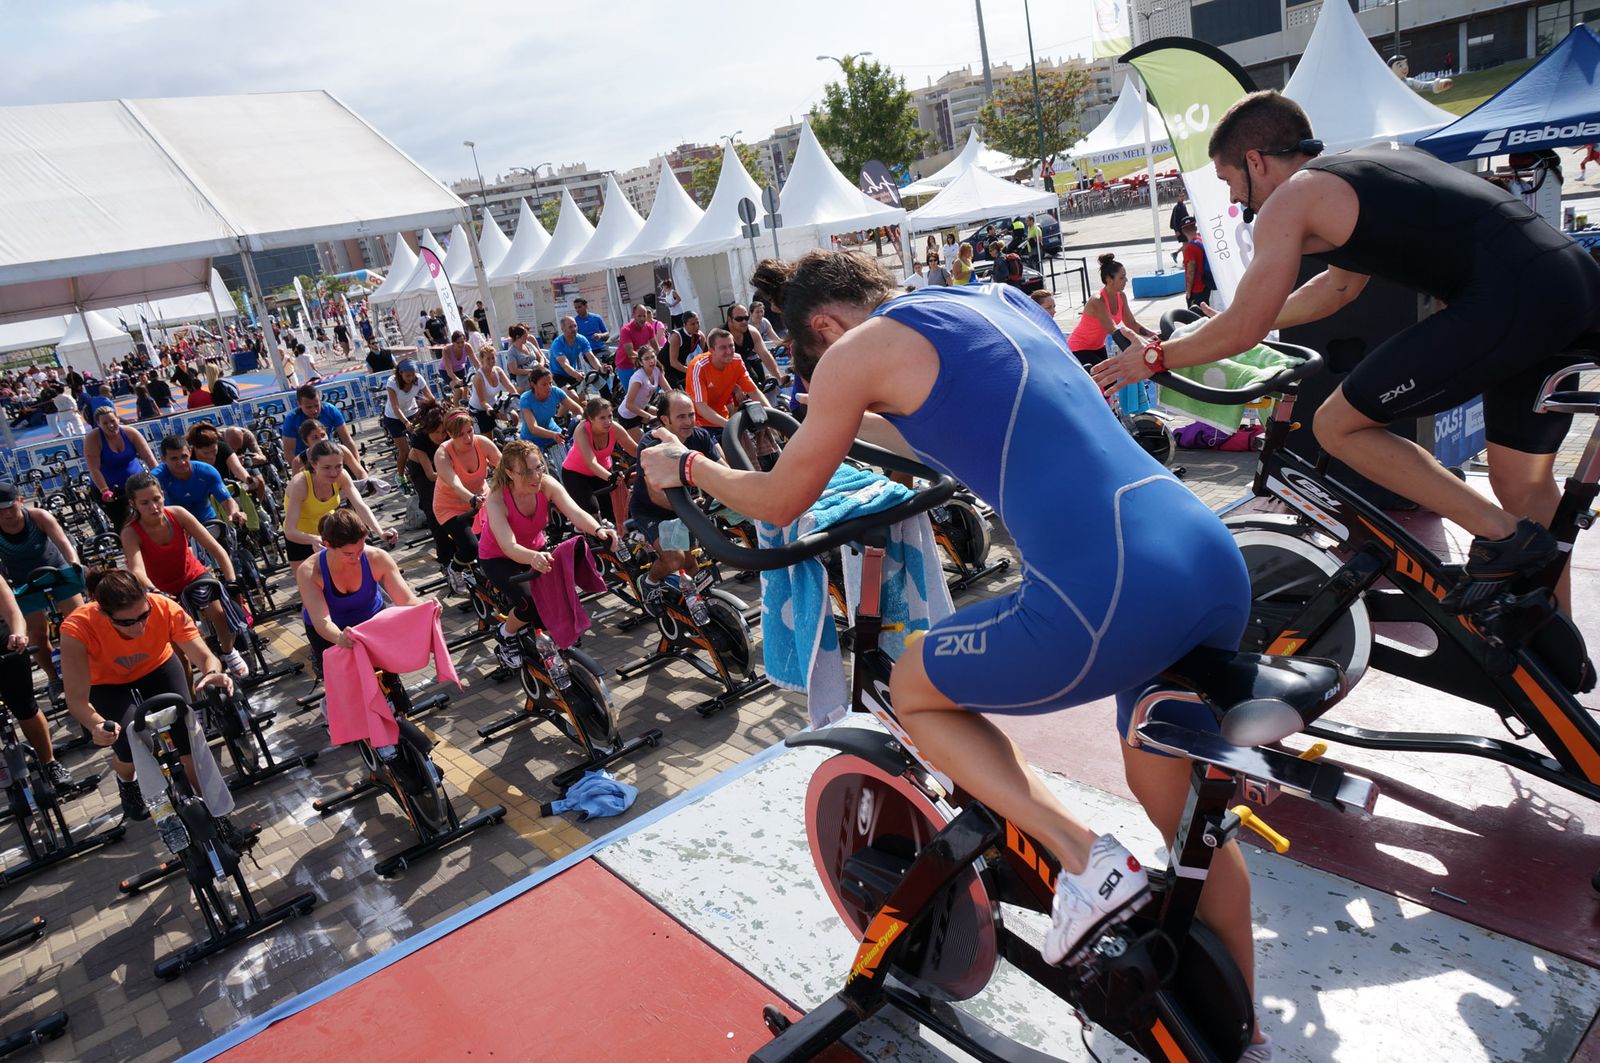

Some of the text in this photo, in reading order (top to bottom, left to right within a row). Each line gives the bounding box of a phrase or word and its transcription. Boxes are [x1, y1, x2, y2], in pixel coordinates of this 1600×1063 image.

[1507, 121, 1600, 146] Babola
[1102, 143, 1168, 163] LOS MELLZOS
[1379, 378, 1416, 404] 2XU
[1296, 479, 1342, 506] BH
[934, 630, 987, 656] 2XU
[1098, 868, 1124, 900] SIDI
